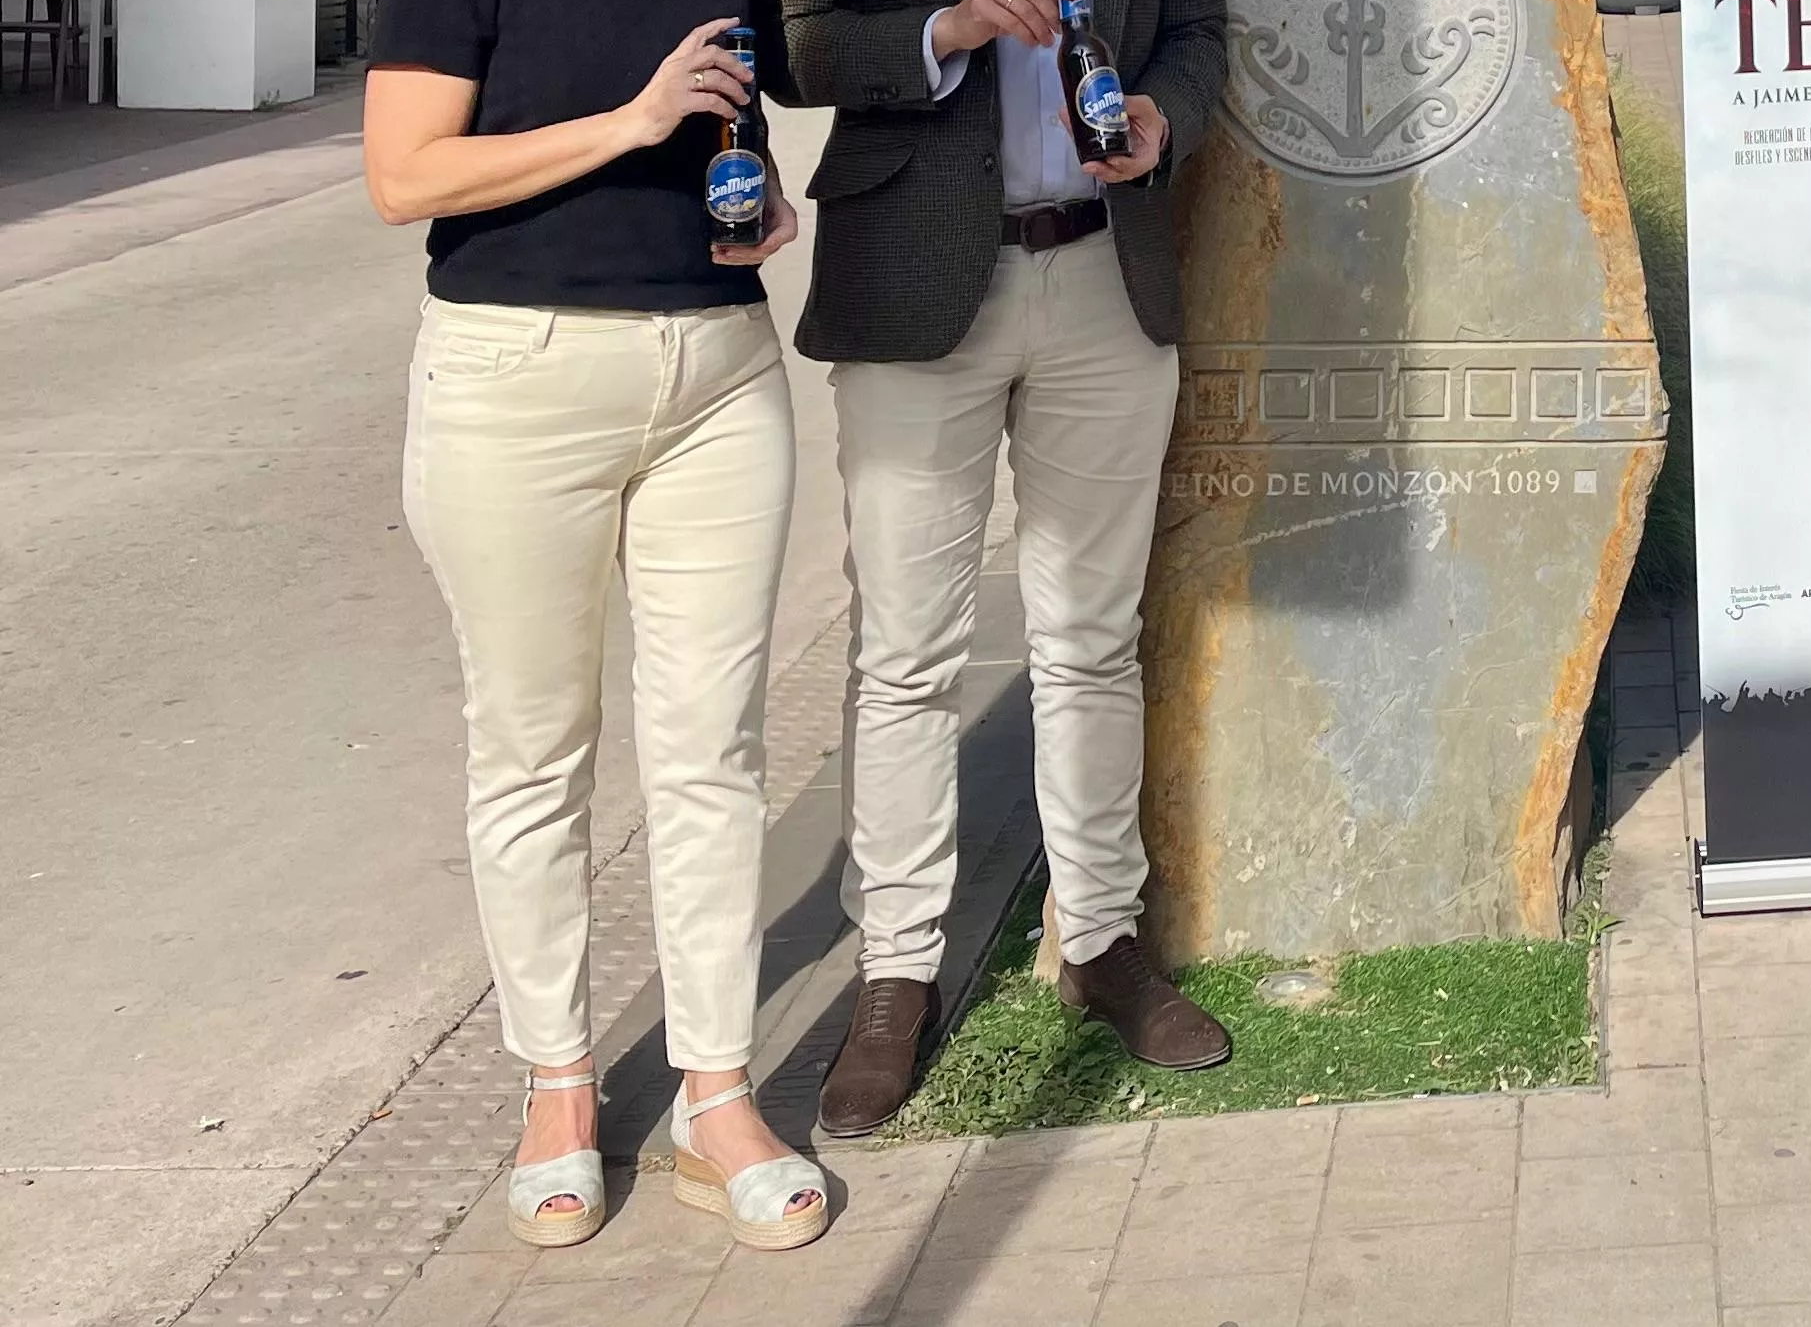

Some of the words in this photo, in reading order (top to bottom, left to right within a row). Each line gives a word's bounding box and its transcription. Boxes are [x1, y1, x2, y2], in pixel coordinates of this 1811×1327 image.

[1733, 91, 1745, 105] A
[1743, 126, 1793, 145] RECREACIÓN
[1796, 127, 1806, 142] DE
[1735, 150, 1772, 165] DESFILES
[1159, 473, 1255, 498] EINO
[1266, 472, 1311, 496] DE
[1491, 469, 1561, 494] 1089
